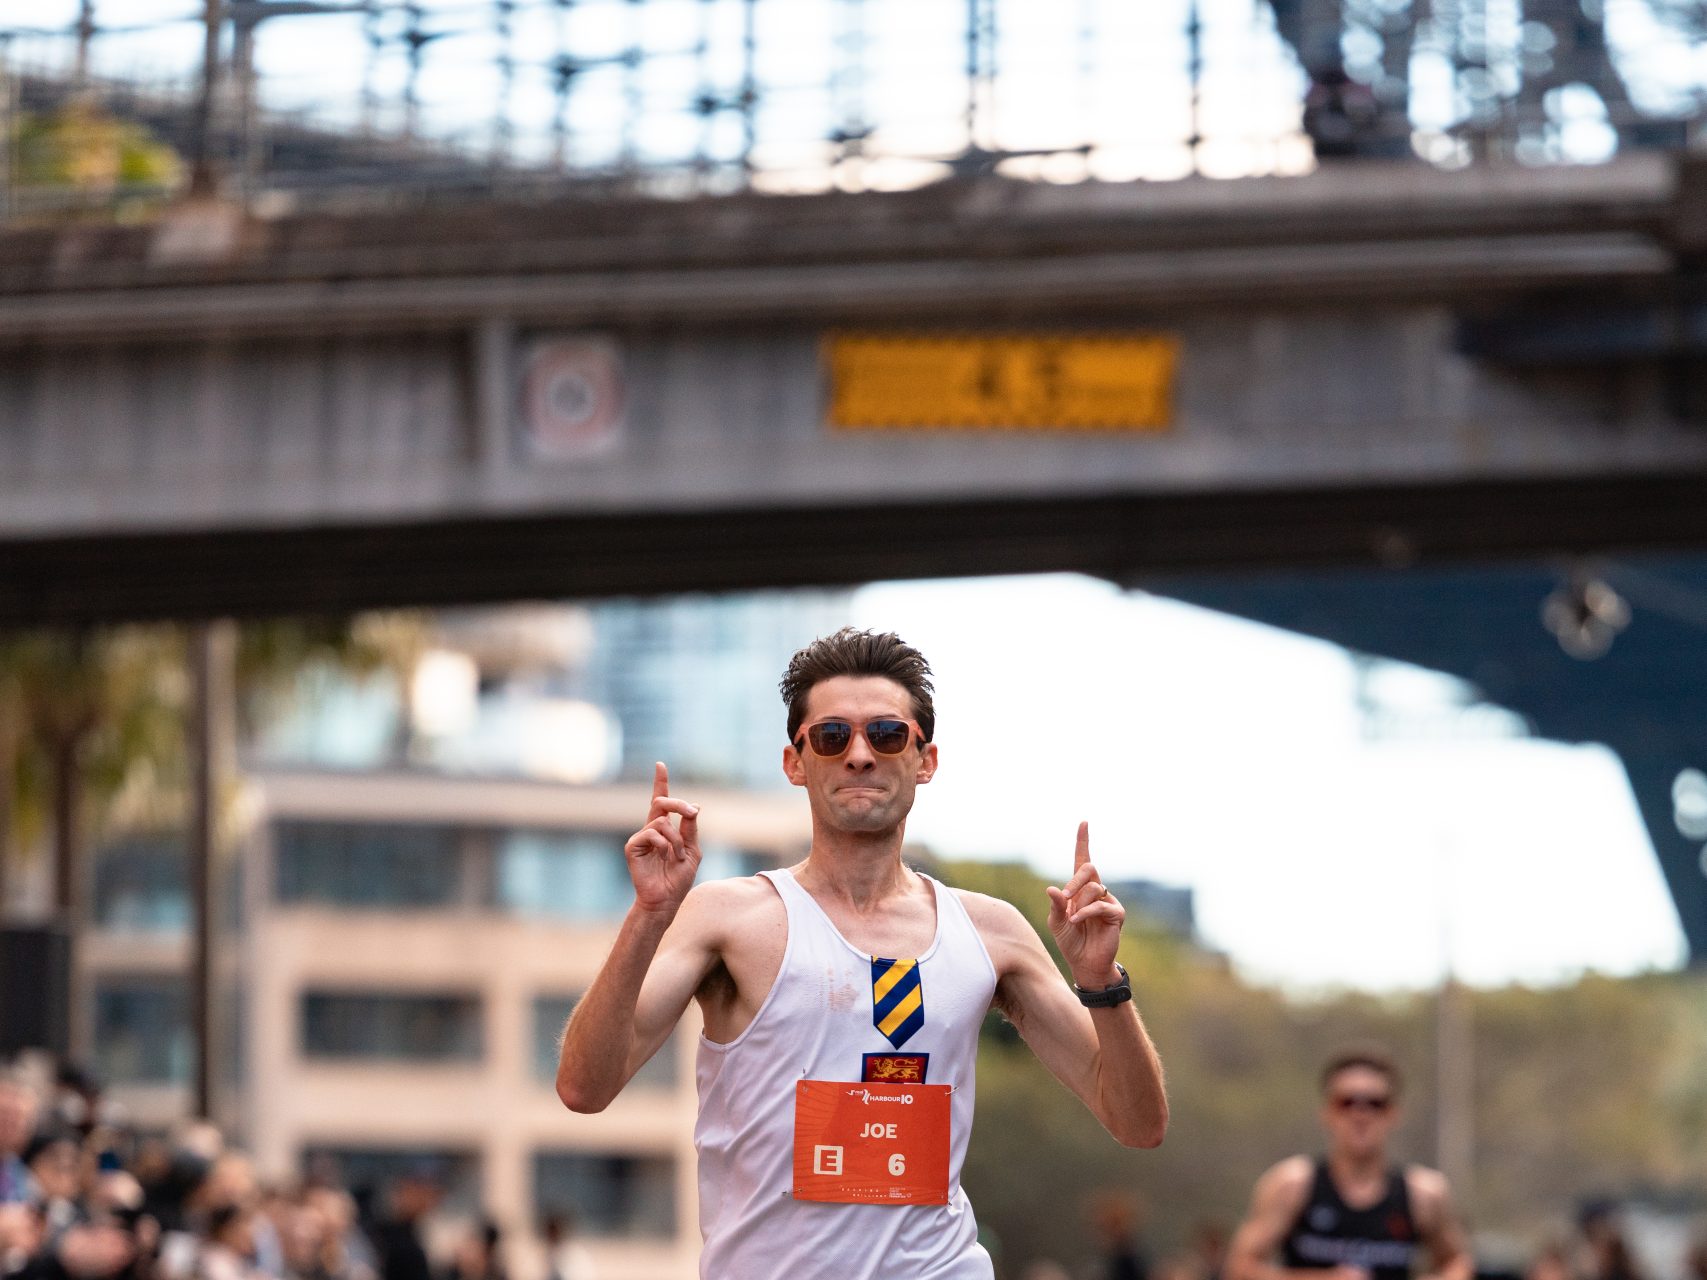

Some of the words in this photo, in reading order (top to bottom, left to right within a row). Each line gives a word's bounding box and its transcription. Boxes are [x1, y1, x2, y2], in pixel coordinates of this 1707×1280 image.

[859, 1122, 898, 1139] JOE
[818, 1147, 840, 1173] E
[888, 1153, 906, 1176] 6
